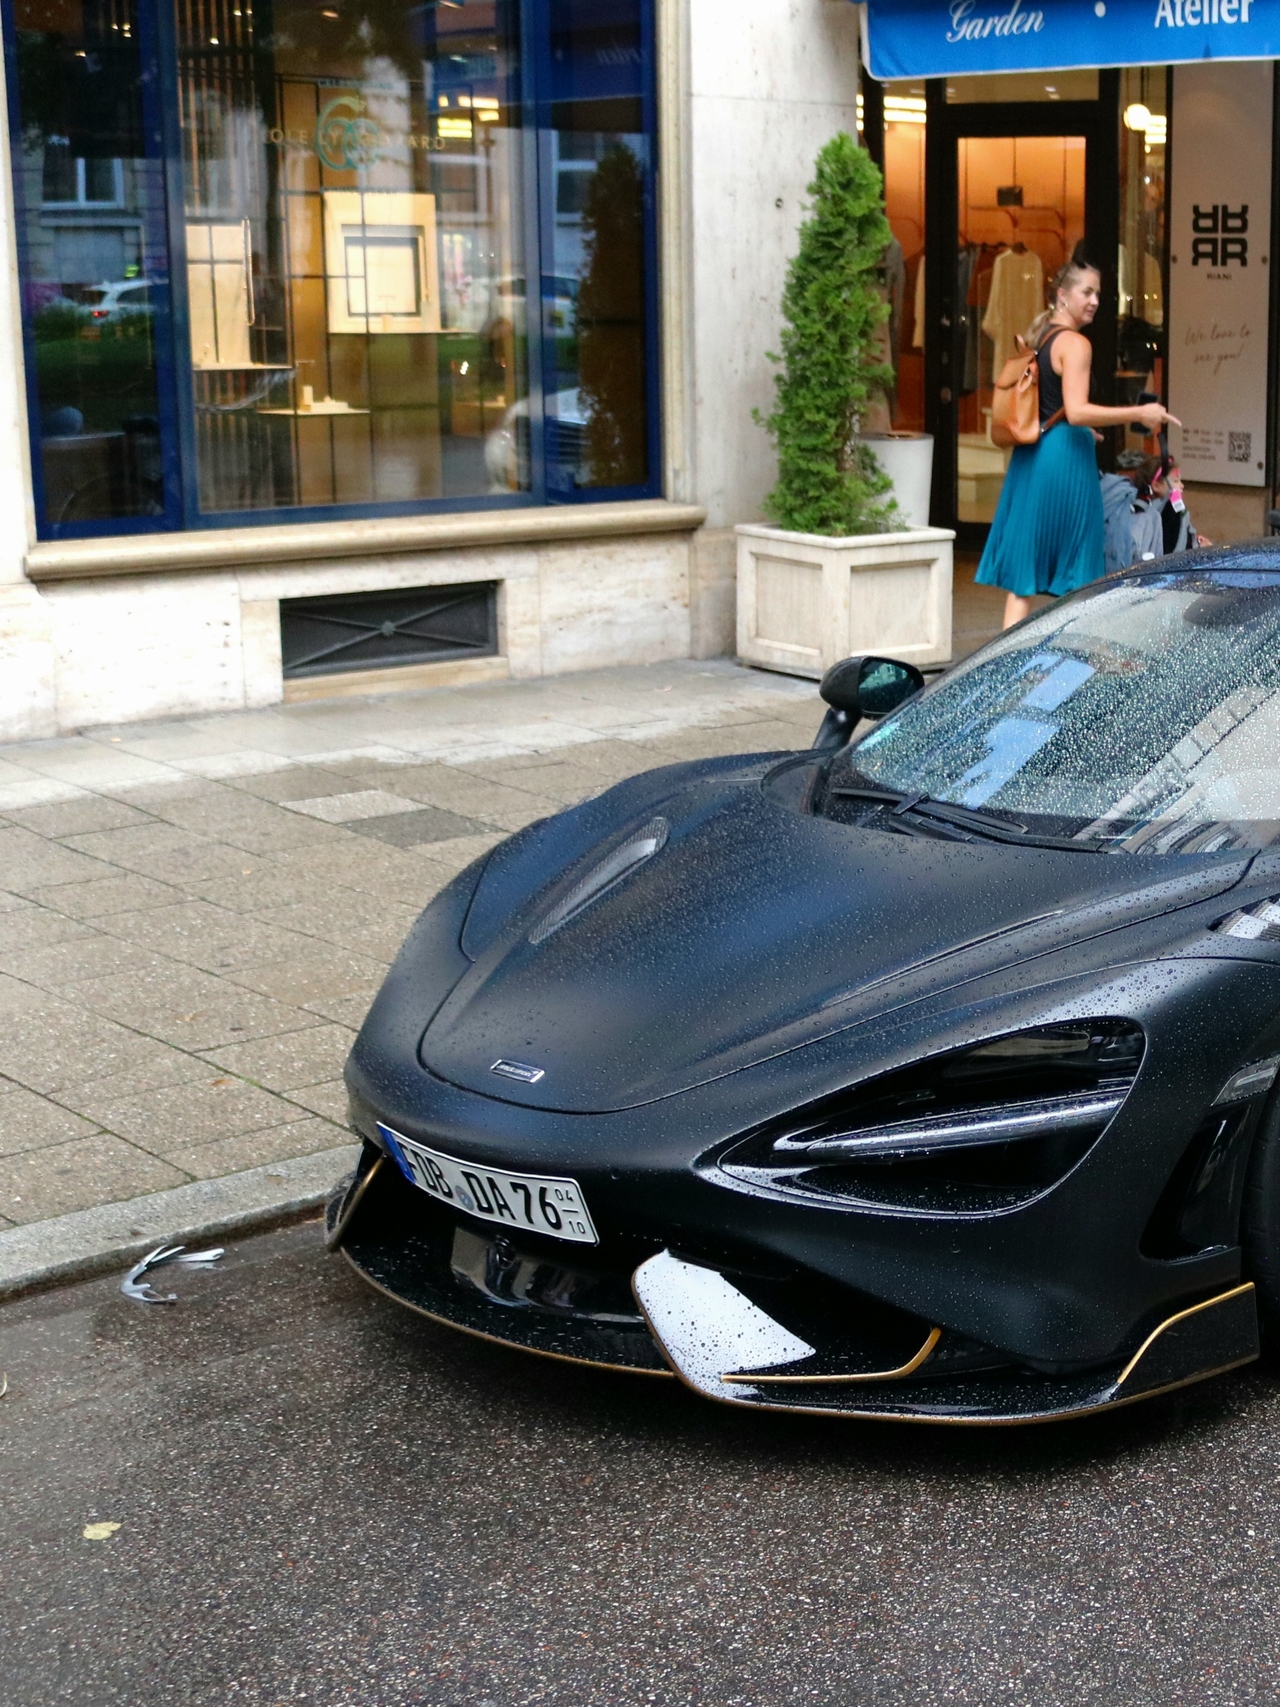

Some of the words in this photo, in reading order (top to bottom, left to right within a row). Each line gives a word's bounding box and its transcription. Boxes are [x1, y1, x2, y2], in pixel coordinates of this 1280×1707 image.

[944, 0, 1045, 43] Garden
[1154, 0, 1254, 28] Atelier
[1206, 273, 1232, 281] RIANI
[1184, 326, 1206, 346] We
[1209, 323, 1235, 341] love
[568, 1220, 587, 1235] 10
